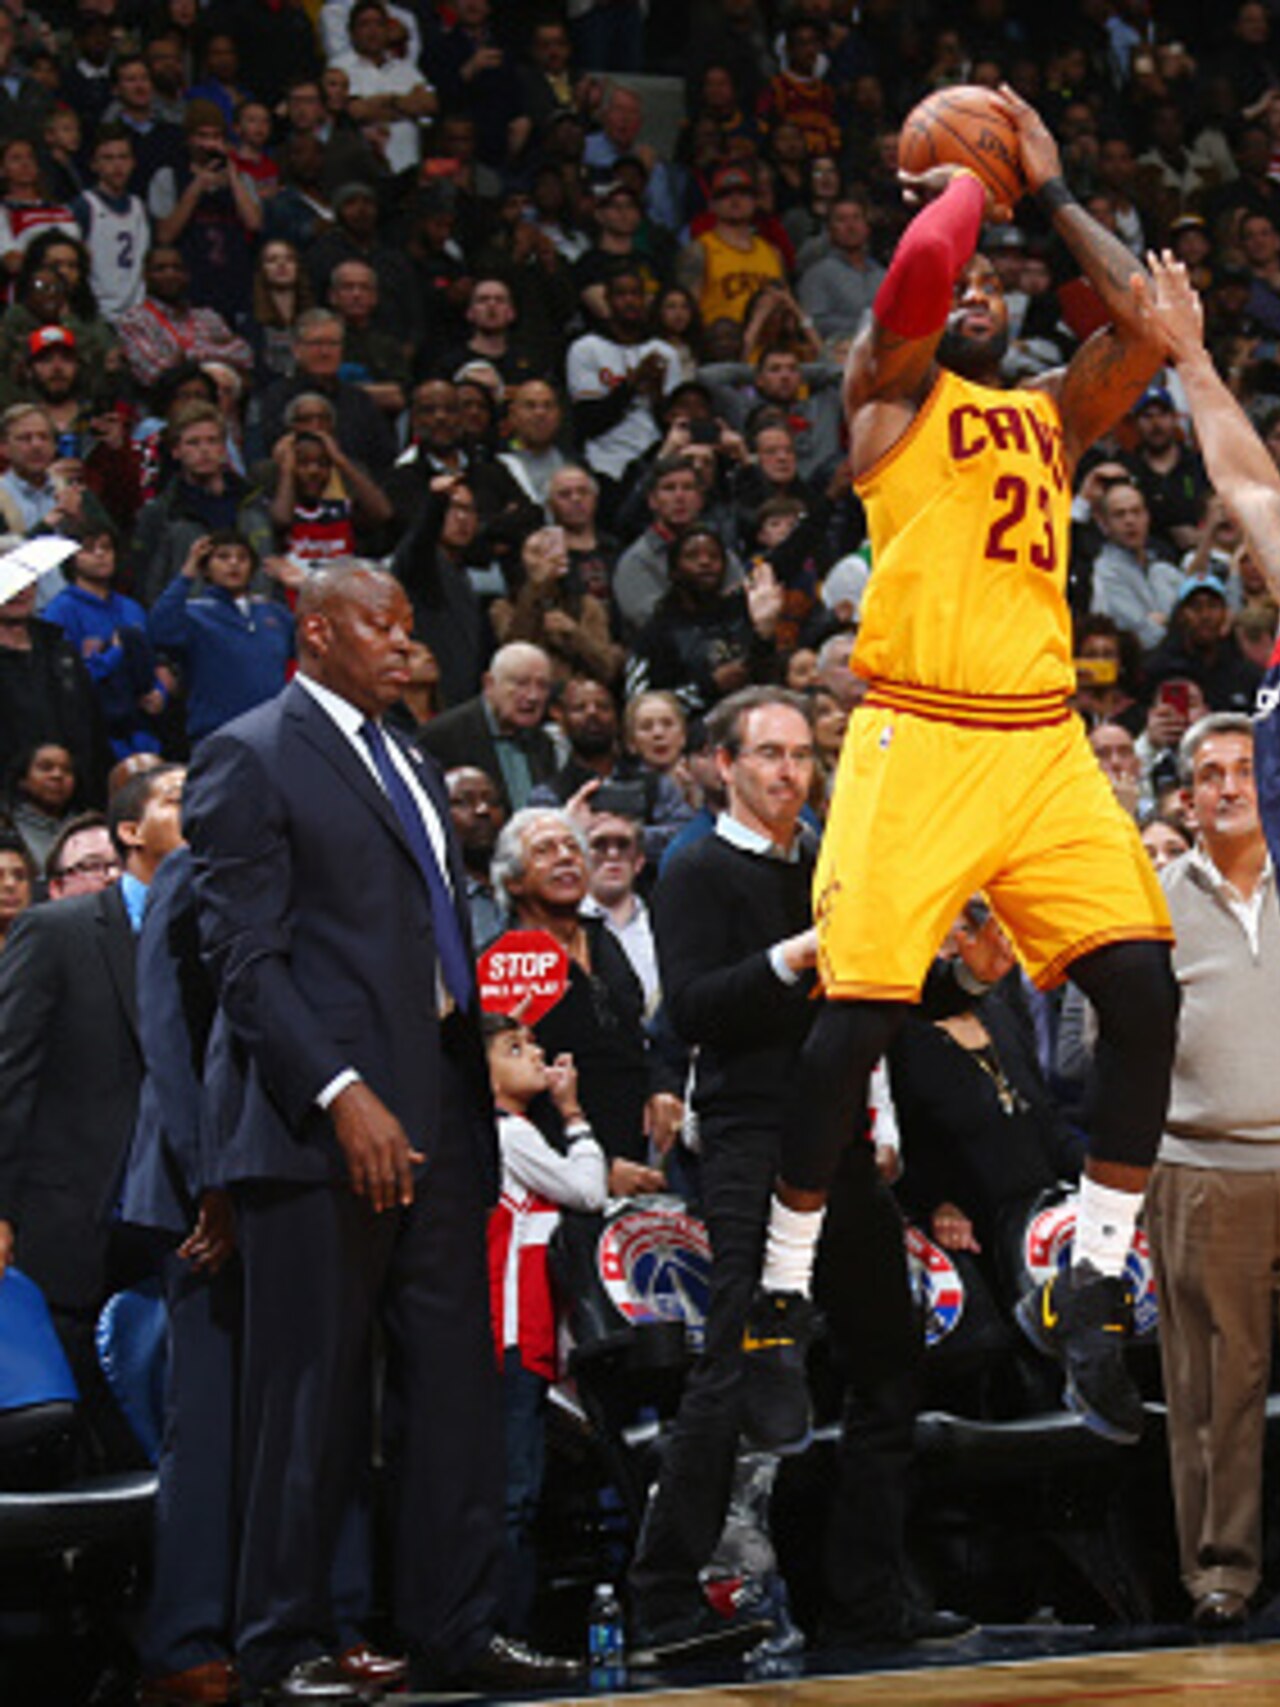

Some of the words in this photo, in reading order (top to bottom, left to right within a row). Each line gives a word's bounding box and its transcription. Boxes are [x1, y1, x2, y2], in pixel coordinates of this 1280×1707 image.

[116, 231, 133, 268] 2
[984, 473, 1057, 573] 23
[488, 952, 559, 980] STOP
